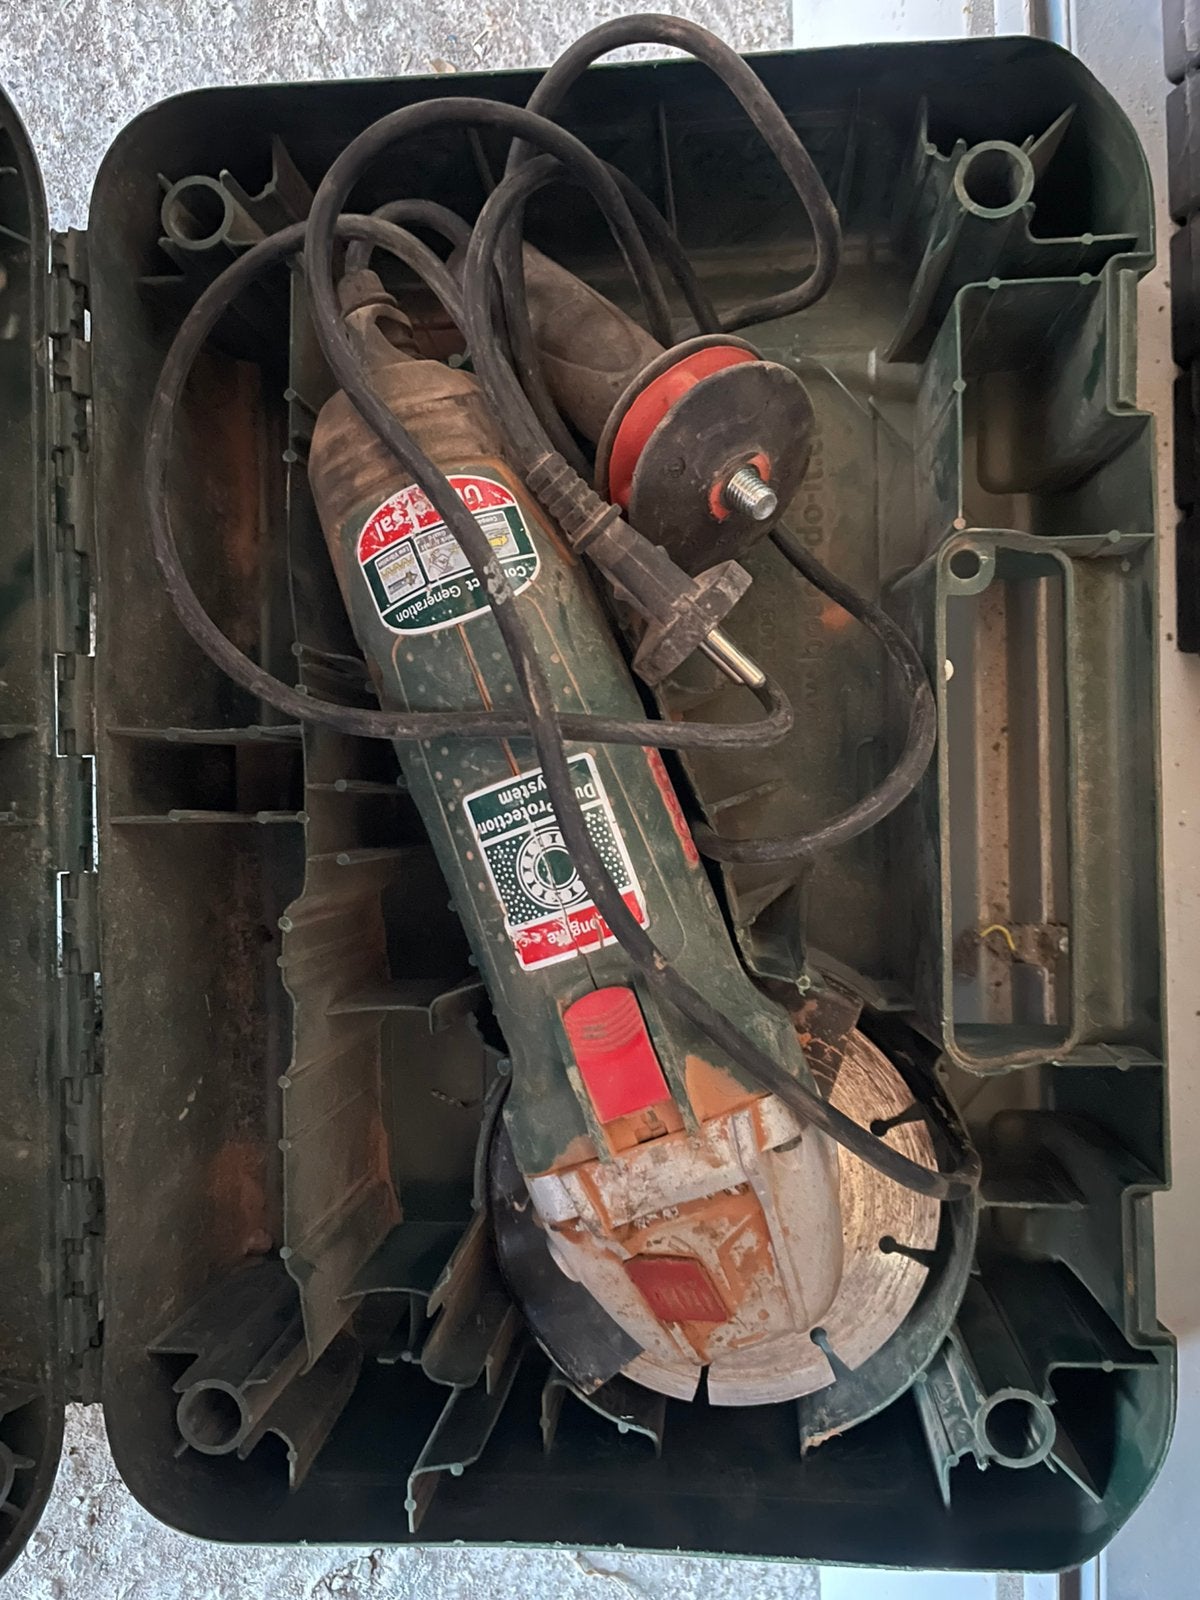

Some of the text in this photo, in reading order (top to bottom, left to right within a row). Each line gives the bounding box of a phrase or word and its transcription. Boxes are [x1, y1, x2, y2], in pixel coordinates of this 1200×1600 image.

[395, 564, 528, 623] Coct Generation
[498, 775, 548, 805] ystem
